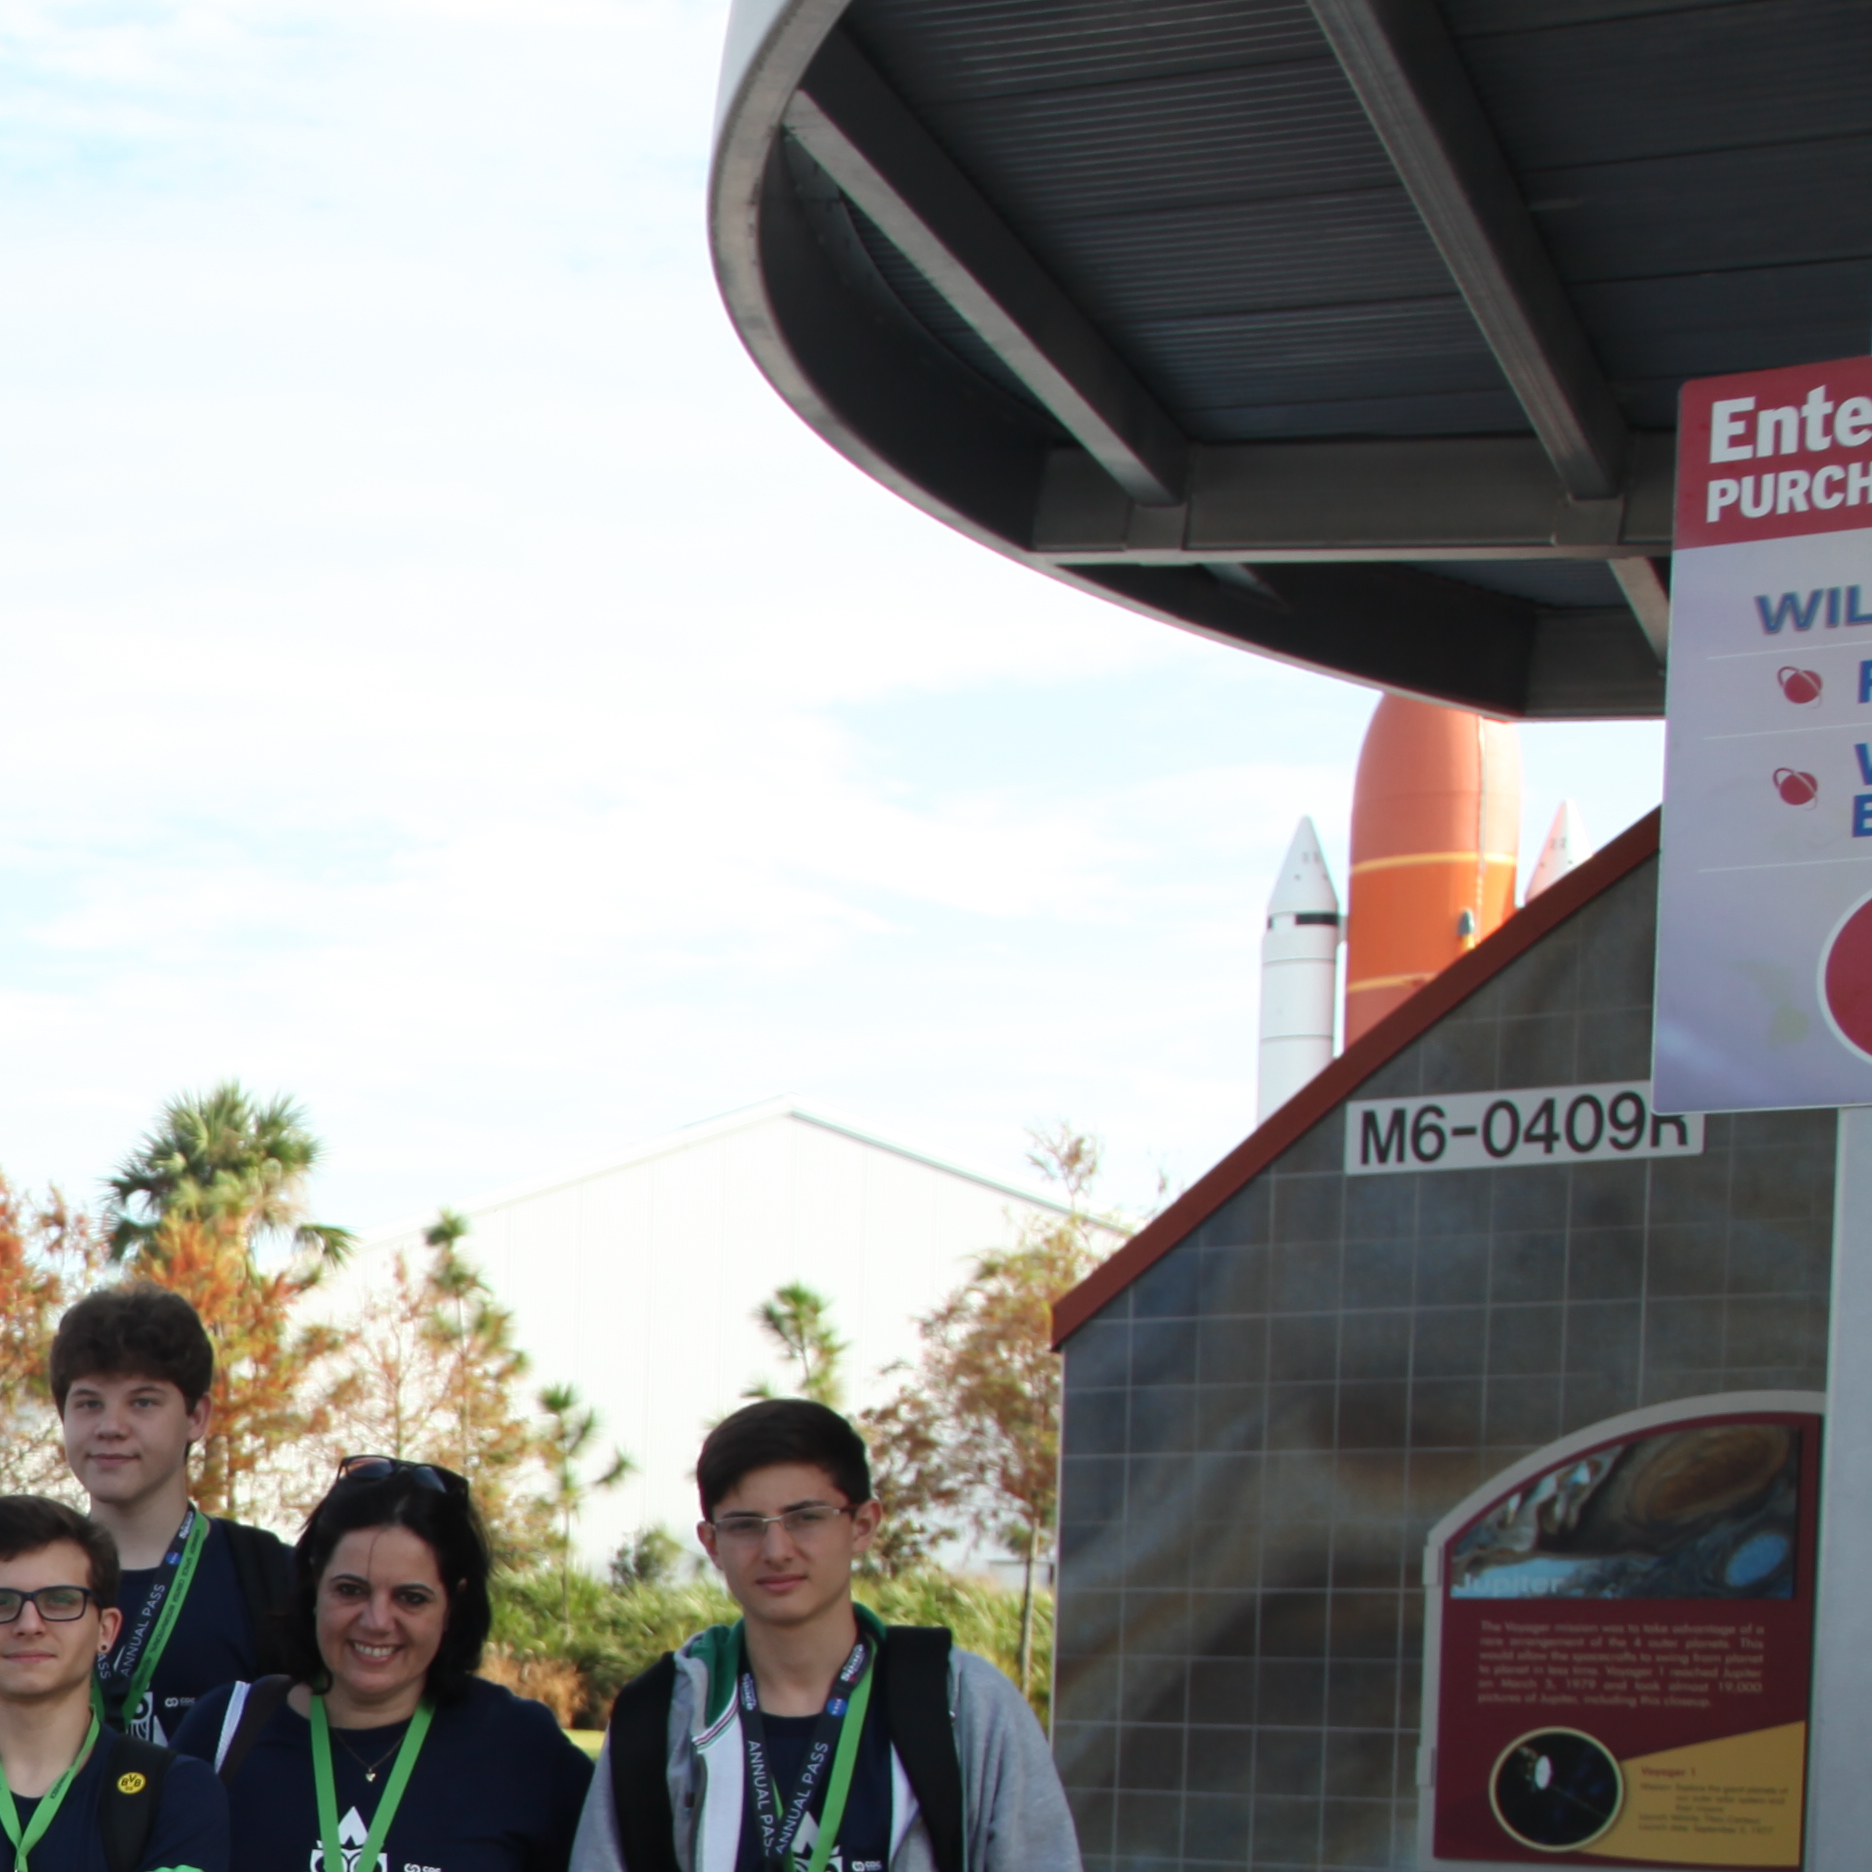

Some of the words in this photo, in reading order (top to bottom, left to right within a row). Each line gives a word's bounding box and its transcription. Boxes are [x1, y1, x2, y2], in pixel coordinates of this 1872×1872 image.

[1709, 384, 1872, 464] Ente
[121, 1621, 150, 1677] ANNUAL
[143, 1584, 165, 1617] PASS
[120, 1773, 142, 1787] BVB
[747, 1740, 769, 1810] ANNUAL
[775, 1789, 811, 1855] ANNUAL
[802, 1741, 829, 1785] PASS
